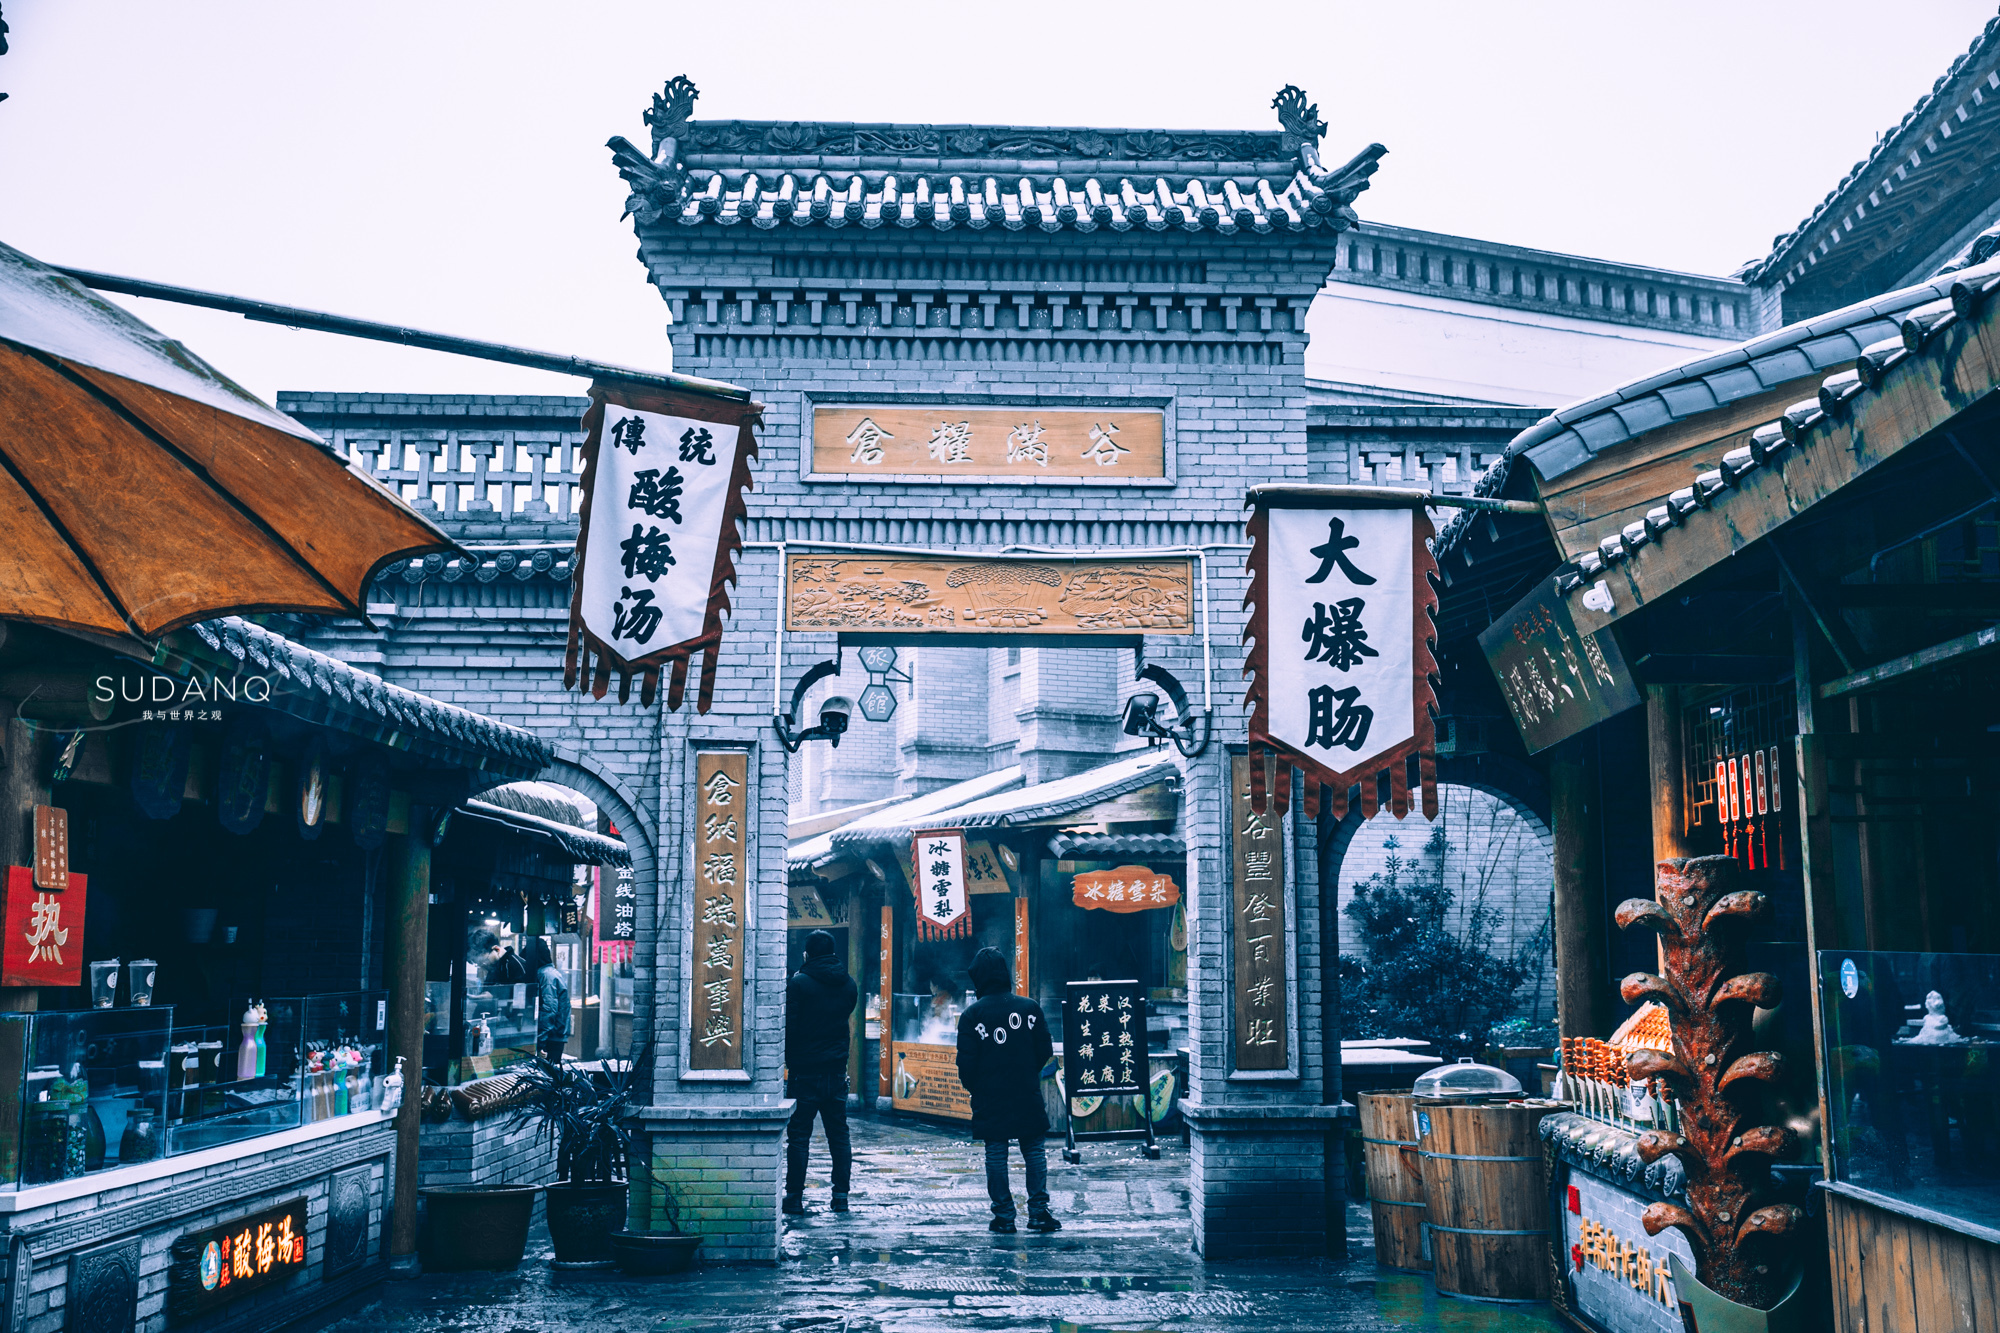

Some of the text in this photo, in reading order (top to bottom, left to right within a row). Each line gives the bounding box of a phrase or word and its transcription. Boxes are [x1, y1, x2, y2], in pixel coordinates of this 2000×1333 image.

[611, 466, 684, 645] 酸梅汤
[1301, 516, 1379, 752] 大爆肠
[613, 865, 636, 938] 金线油塔
[928, 840, 954, 918] 冰糖雪梨
[1083, 878, 1167, 903] 冰糖雪梨
[1241, 783, 1277, 1046] 谷豐登百業旺
[25, 892, 69, 966] 热
[1098, 993, 1115, 1084] 菜豆腐
[1117, 995, 1136, 1083] 汉中热米皮
